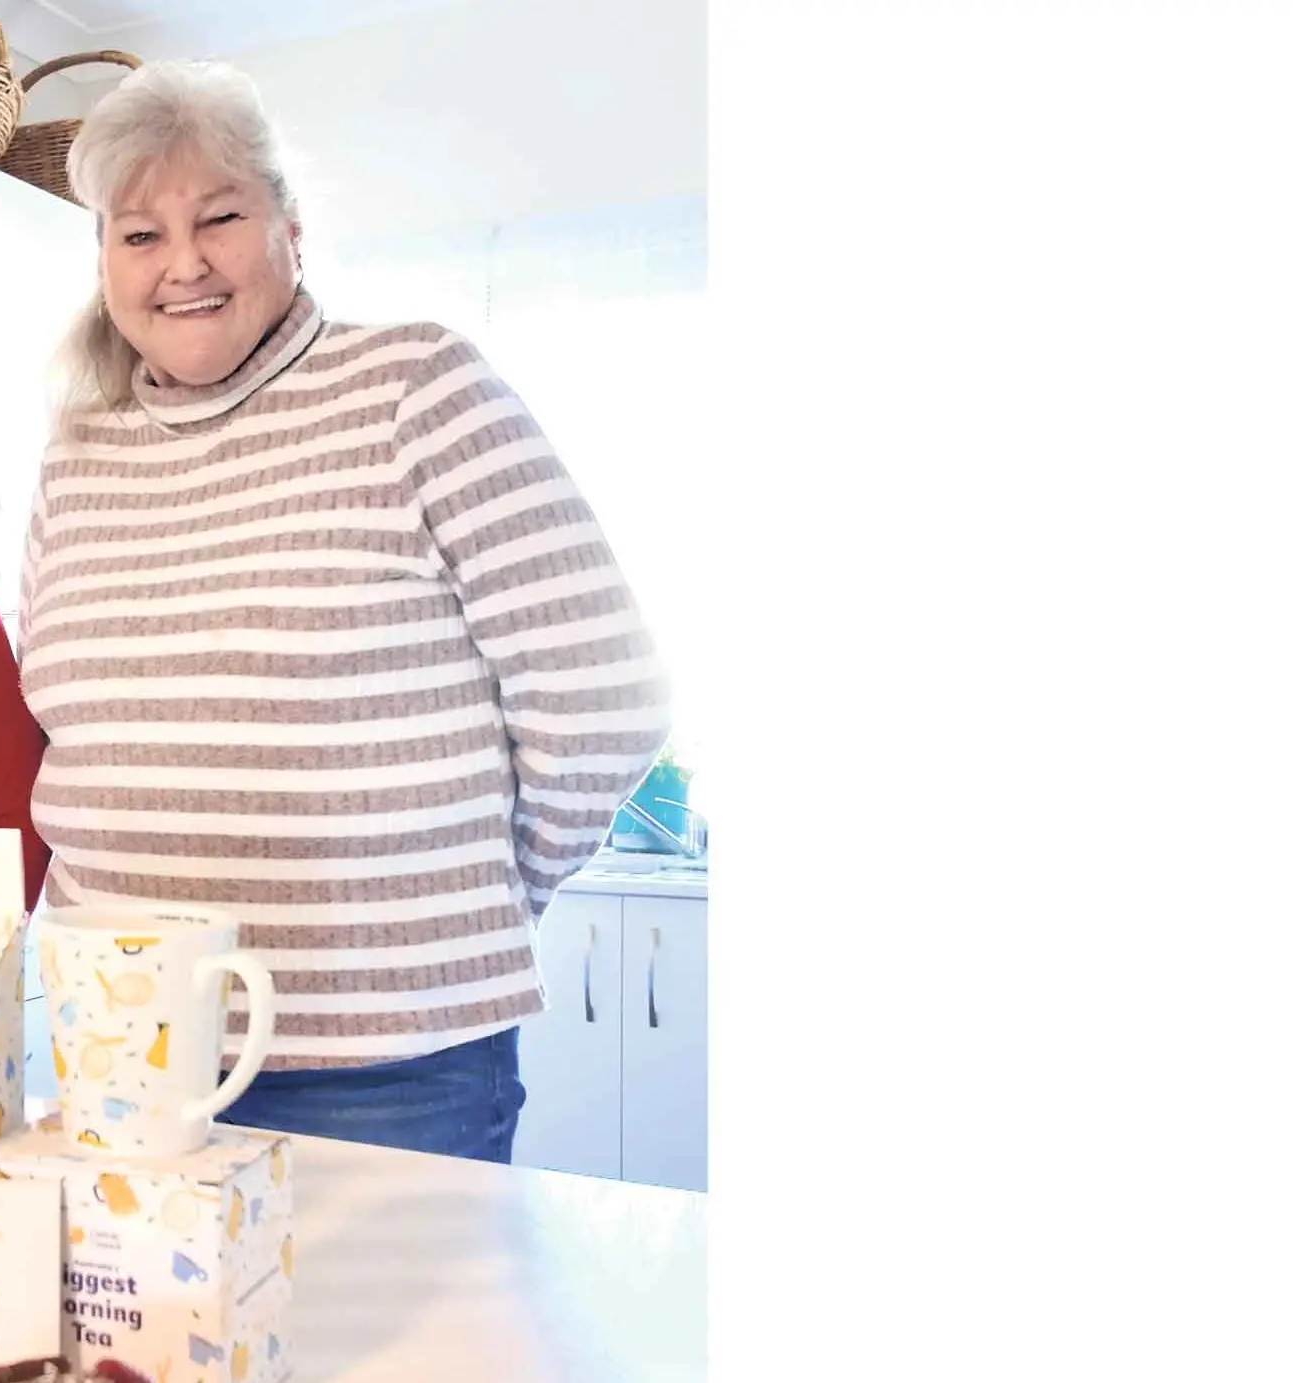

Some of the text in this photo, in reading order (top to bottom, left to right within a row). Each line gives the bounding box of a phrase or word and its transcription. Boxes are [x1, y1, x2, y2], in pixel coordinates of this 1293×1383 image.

[62, 1262, 138, 1296] iggest
[64, 1298, 143, 1332] orning
[71, 1321, 113, 1347] Tea
